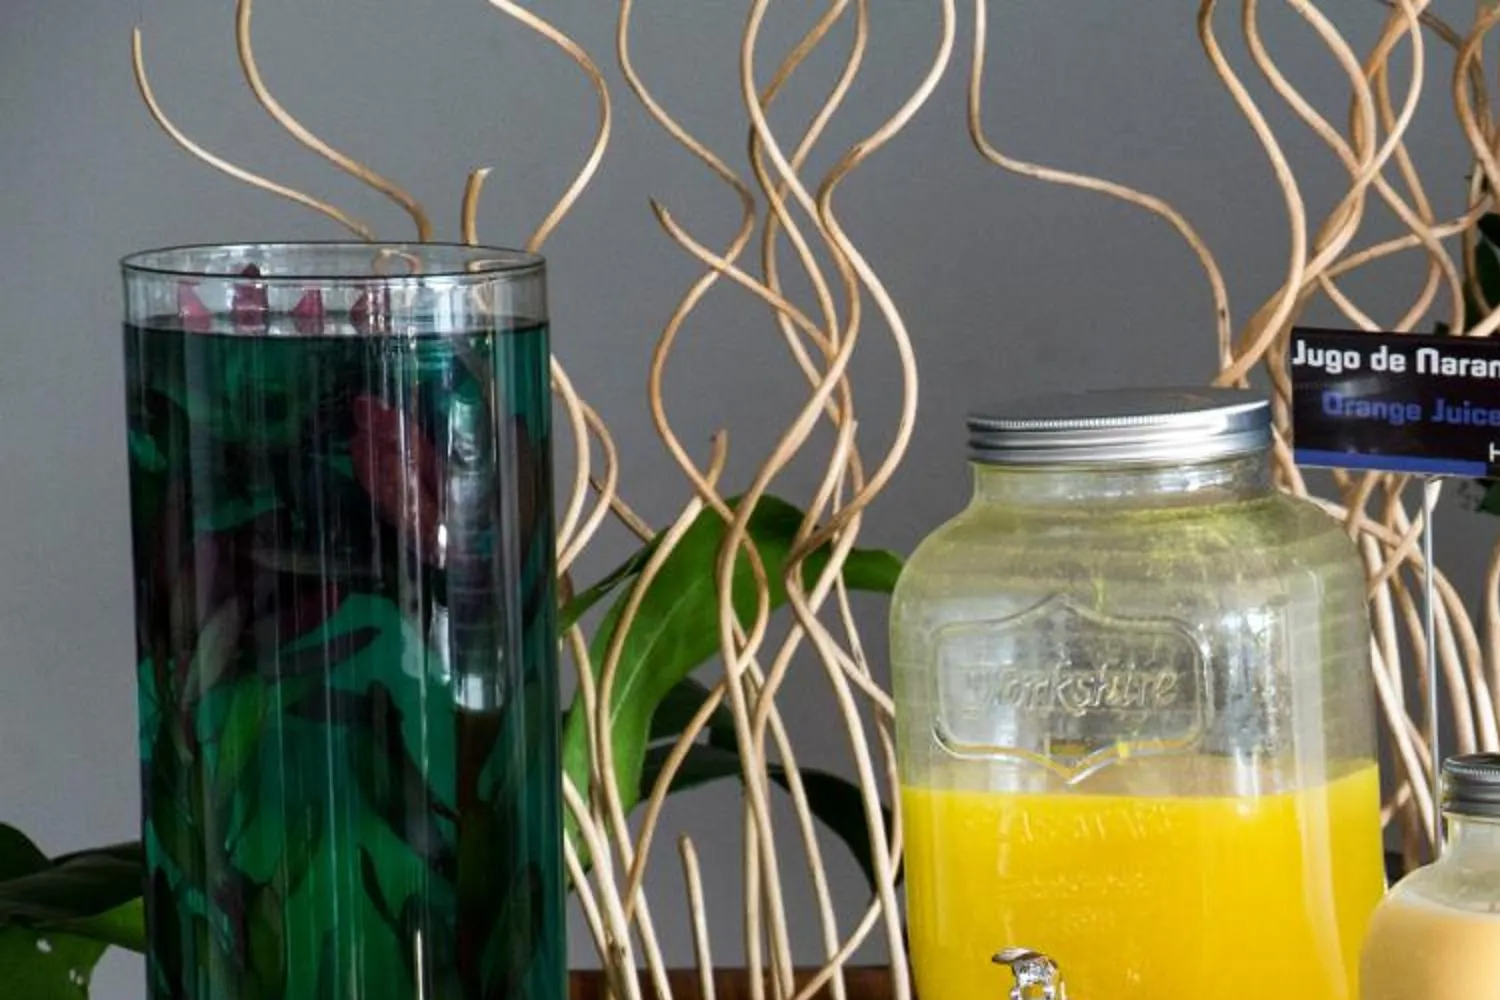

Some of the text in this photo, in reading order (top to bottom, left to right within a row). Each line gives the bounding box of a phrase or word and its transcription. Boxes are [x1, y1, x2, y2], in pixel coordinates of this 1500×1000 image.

[1292, 339, 1360, 374] Jugo
[1370, 345, 1406, 372] de
[1321, 391, 1421, 424] Orange
